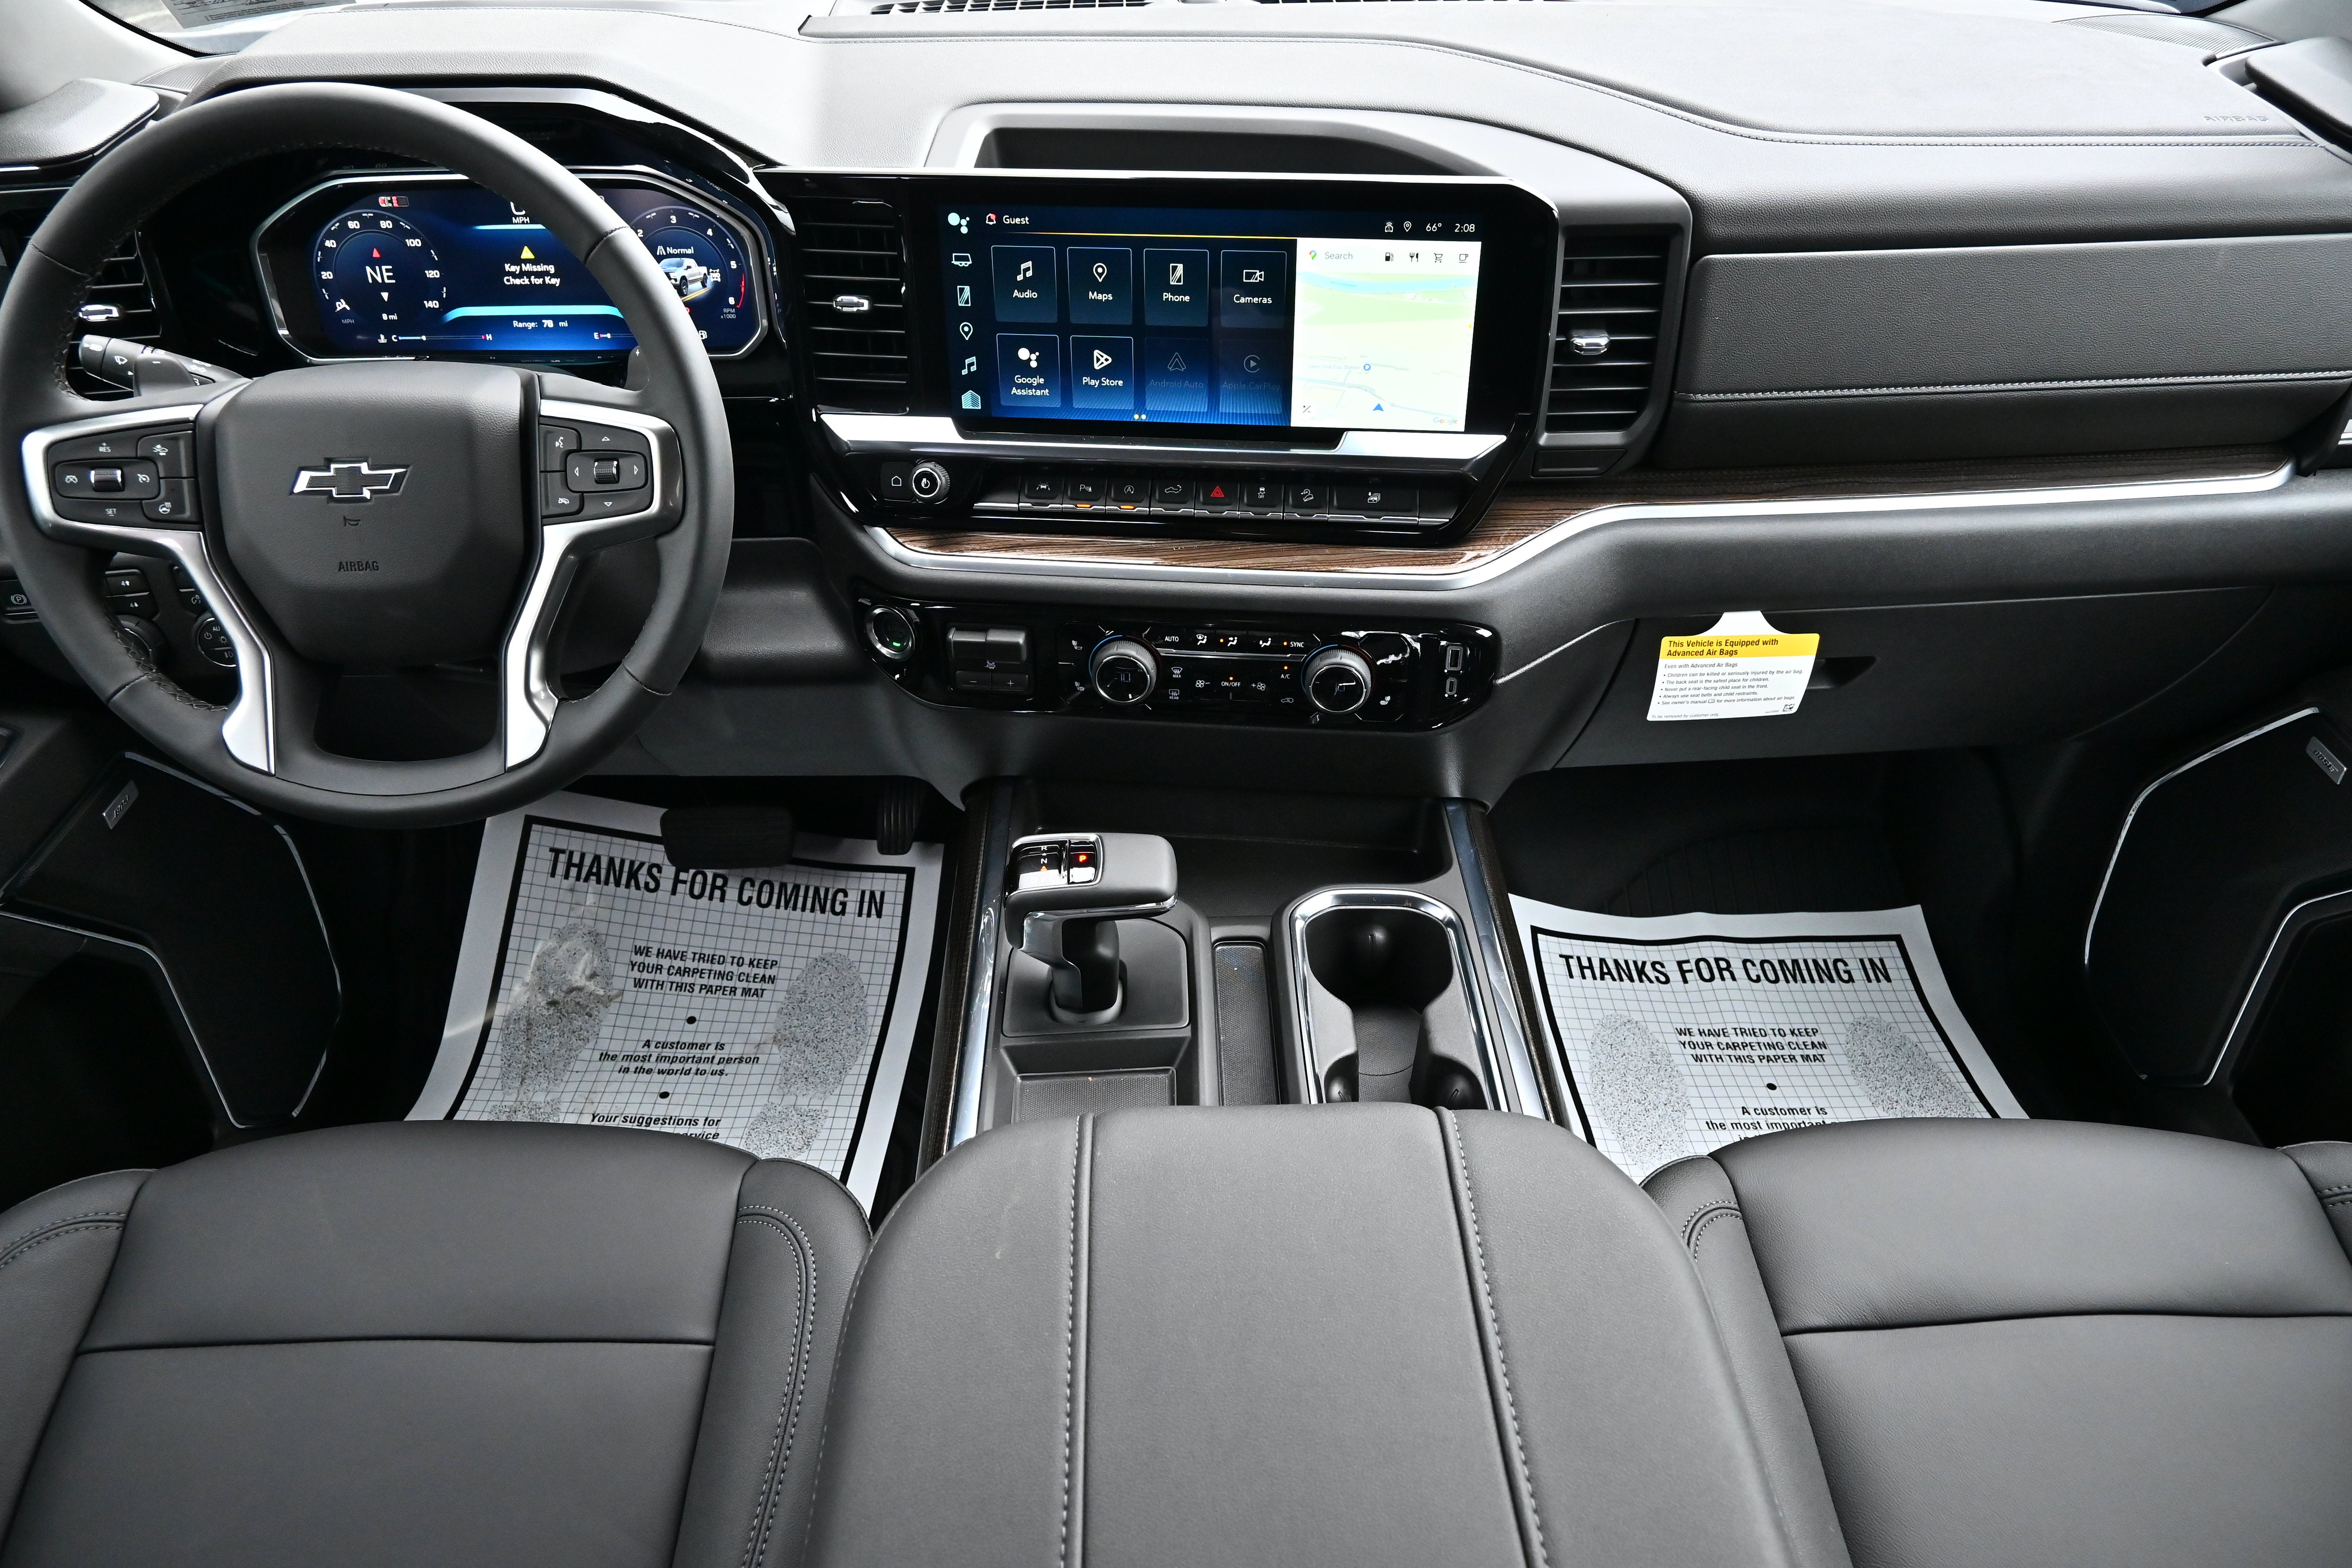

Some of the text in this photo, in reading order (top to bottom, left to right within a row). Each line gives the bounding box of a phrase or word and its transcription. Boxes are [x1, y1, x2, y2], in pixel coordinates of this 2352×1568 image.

[348, 220, 360, 229] 60
[380, 220, 392, 229] 80
[670, 215, 676, 224] 3
[1003, 215, 1029, 225] Guest
[1454, 223, 1475, 232] 2:08
[637, 229, 643, 237] 2
[706, 229, 713, 237] 4
[405, 239, 422, 248] 100
[666, 246, 694, 254] Normal
[1324, 252, 1353, 260] Search
[504, 263, 555, 274] Key Missing
[730, 261, 737, 269] 5
[321, 271, 333, 279] 20
[365, 266, 396, 283] NE
[425, 270, 440, 278] 120
[504, 275, 561, 286] Check for Key
[1013, 289, 1038, 299] Audio
[1089, 291, 1113, 302] Maps
[1163, 293, 1190, 302] Phone
[1233, 294, 1272, 304] Cameras
[424, 300, 439, 309] 140
[513, 321, 538, 329] Range:
[542, 320, 554, 328] 78
[1015, 376, 1045, 386] Google
[1083, 377, 1124, 387] Play Store
[1149, 380, 1204, 389] Android Auto
[1011, 387, 1050, 396] Assistant
[1222, 382, 1247, 392] Apple
[338, 561, 379, 572] AIRBAG
[1725, 639, 1760, 648] Equipped
[1719, 648, 1738, 656] Bags
[548, 847, 885, 919] THANKS FOR COMING IN
[634, 945, 778, 969] WE HAVE TRIED TO KEEP
[630, 961, 776, 984] YOUR CARPETING CLEAN
[1559, 954, 1893, 985] THANKS FOR COMING IN
[633, 977, 766, 998] WITH THIS PAPER MAT
[1675, 1027, 1818, 1037] WE HAVE TRIED TO KEEP
[642, 1040, 725, 1051] A customer is
[1679, 1041, 1827, 1051] YOUR CARPETING CLEAN
[599, 1052, 760, 1065] the most important person
[1691, 1054, 1826, 1063] WITH THIS PAPER MAT
[618, 1065, 728, 1076] in the world to us.
[1742, 1106, 1827, 1116] A customer is
[591, 1113, 721, 1127] Your suggestions for
[1706, 1120, 1726, 1130] the
[1730, 1121, 1763, 1130] most
[676, 1131, 719, 1139] rvice
